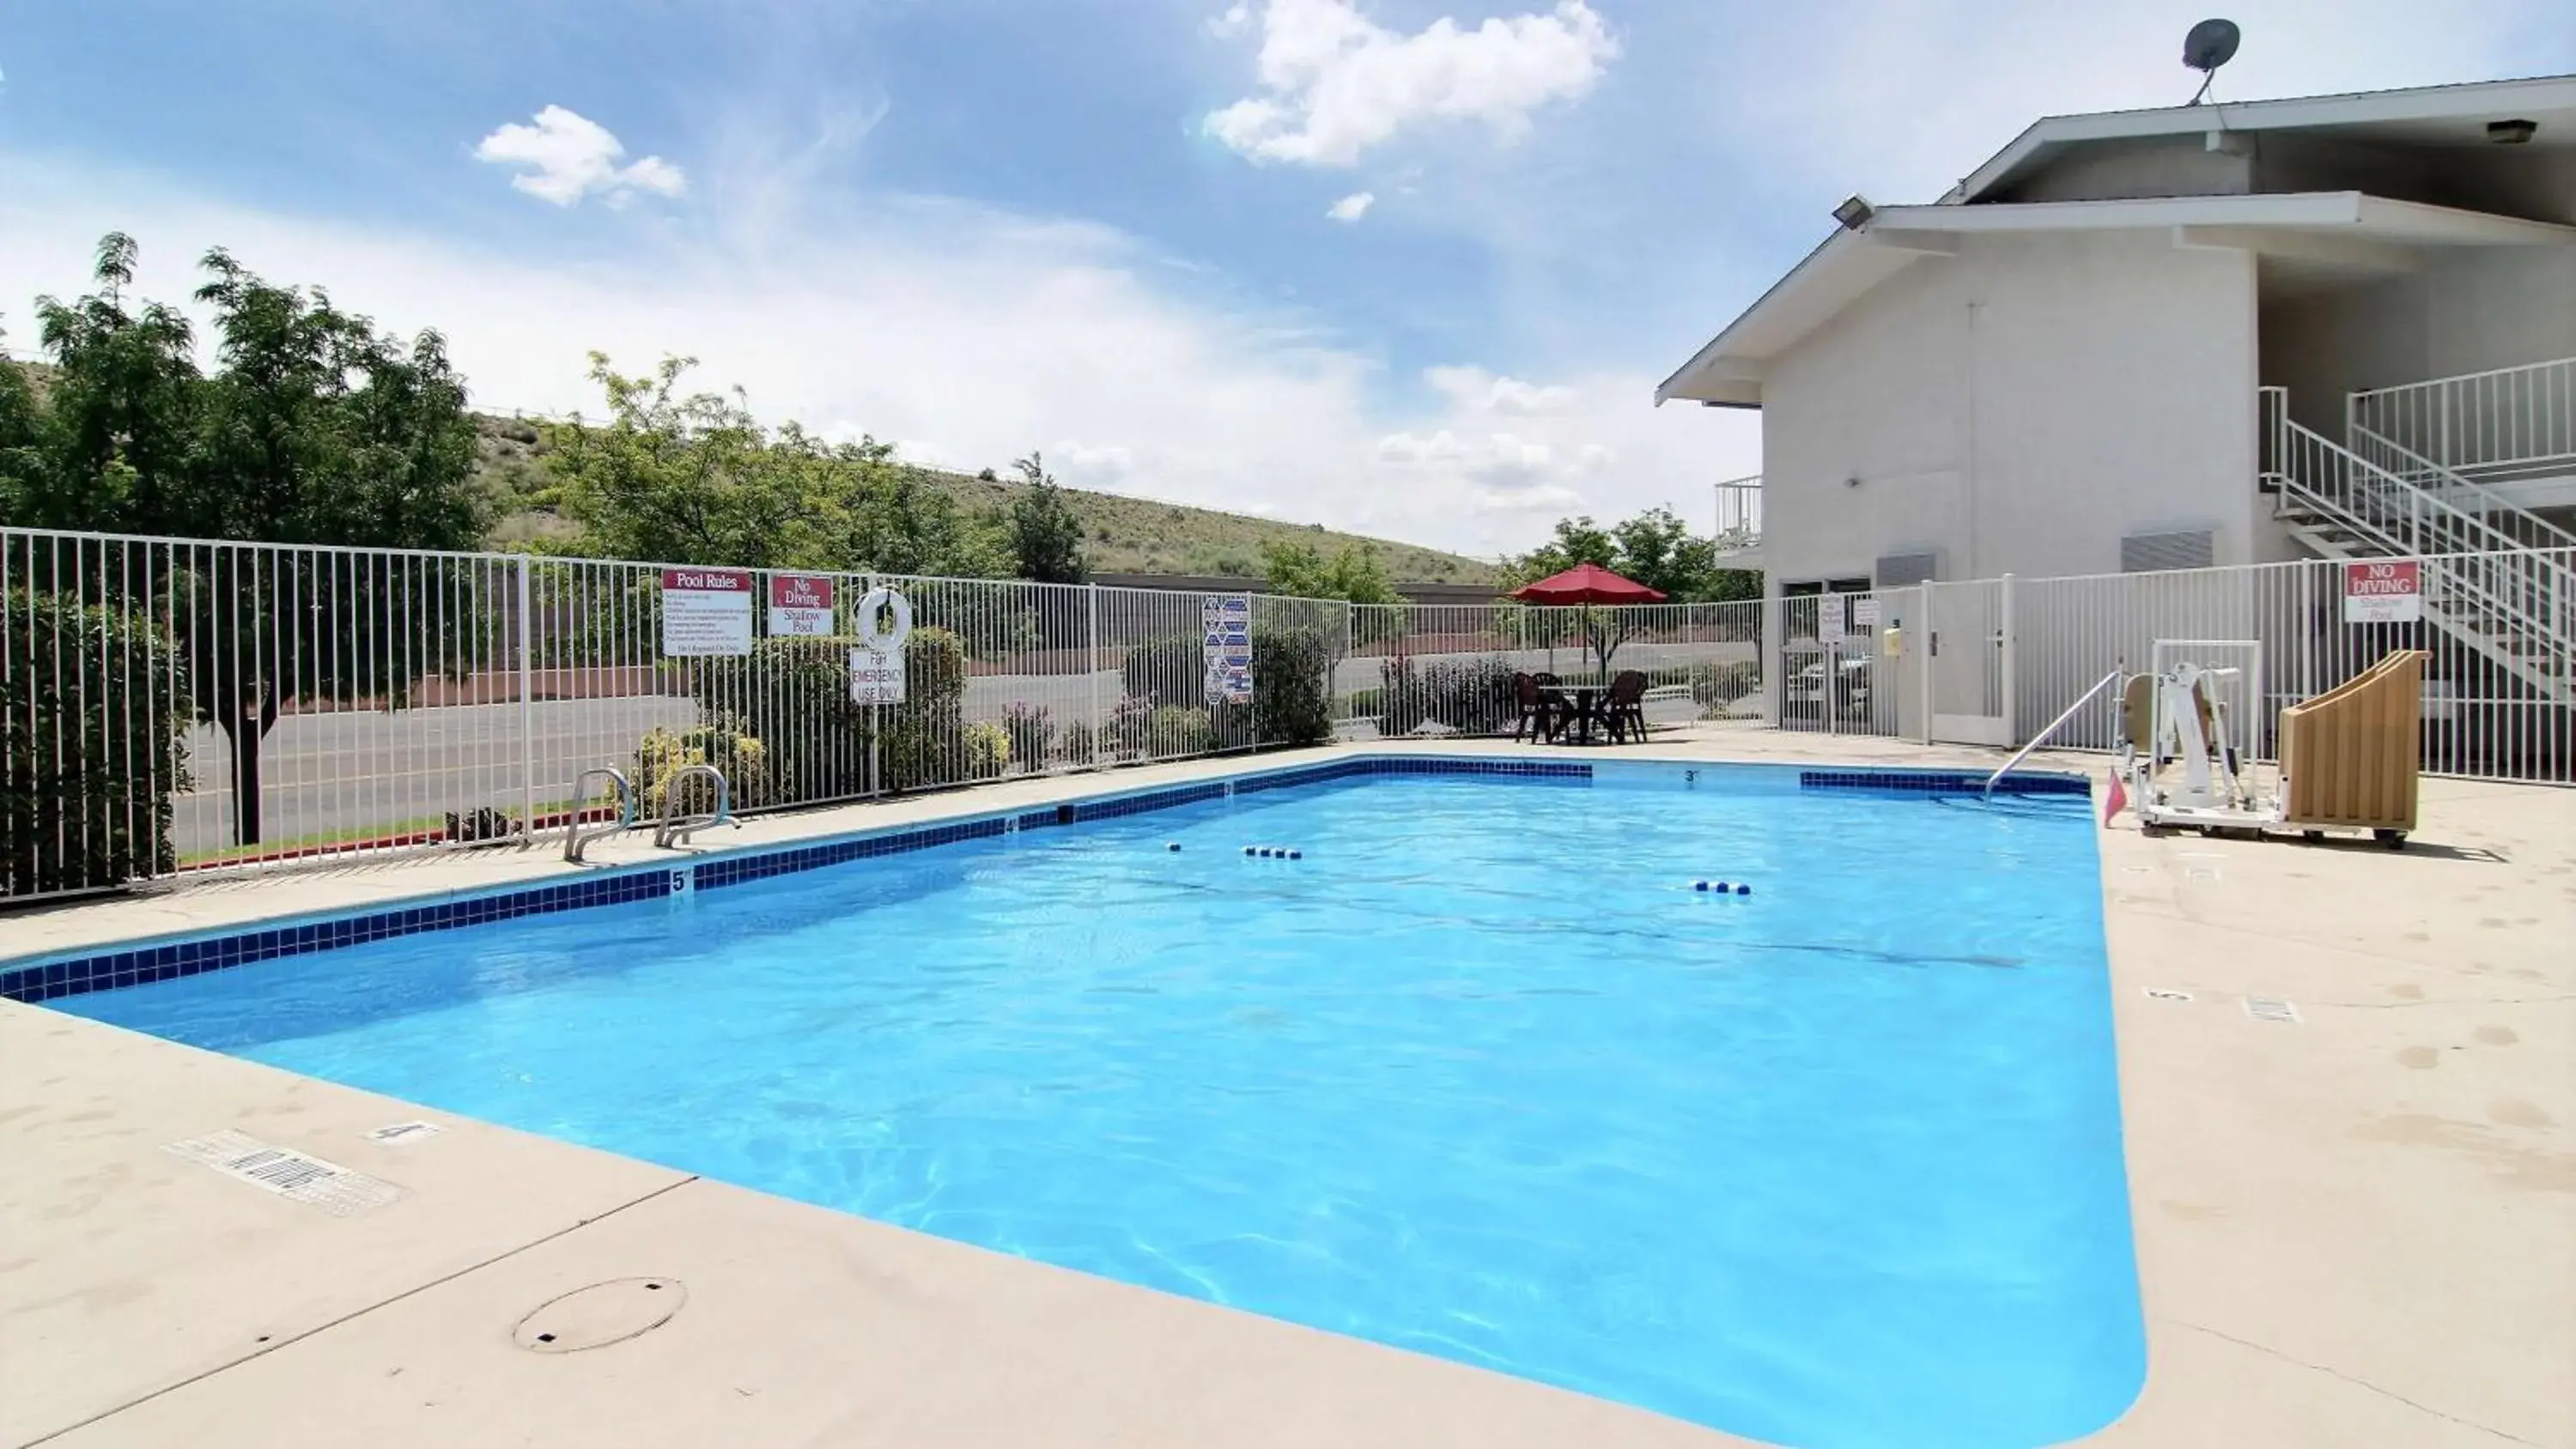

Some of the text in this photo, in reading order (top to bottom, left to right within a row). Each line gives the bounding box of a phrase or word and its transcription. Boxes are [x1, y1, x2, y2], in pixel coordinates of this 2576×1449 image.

[2368, 564, 2396, 579] NO
[677, 573, 738, 589] Pool Rules
[794, 579, 811, 595] No
[2353, 578, 2411, 595] DIVING
[785, 591, 820, 607] Diving
